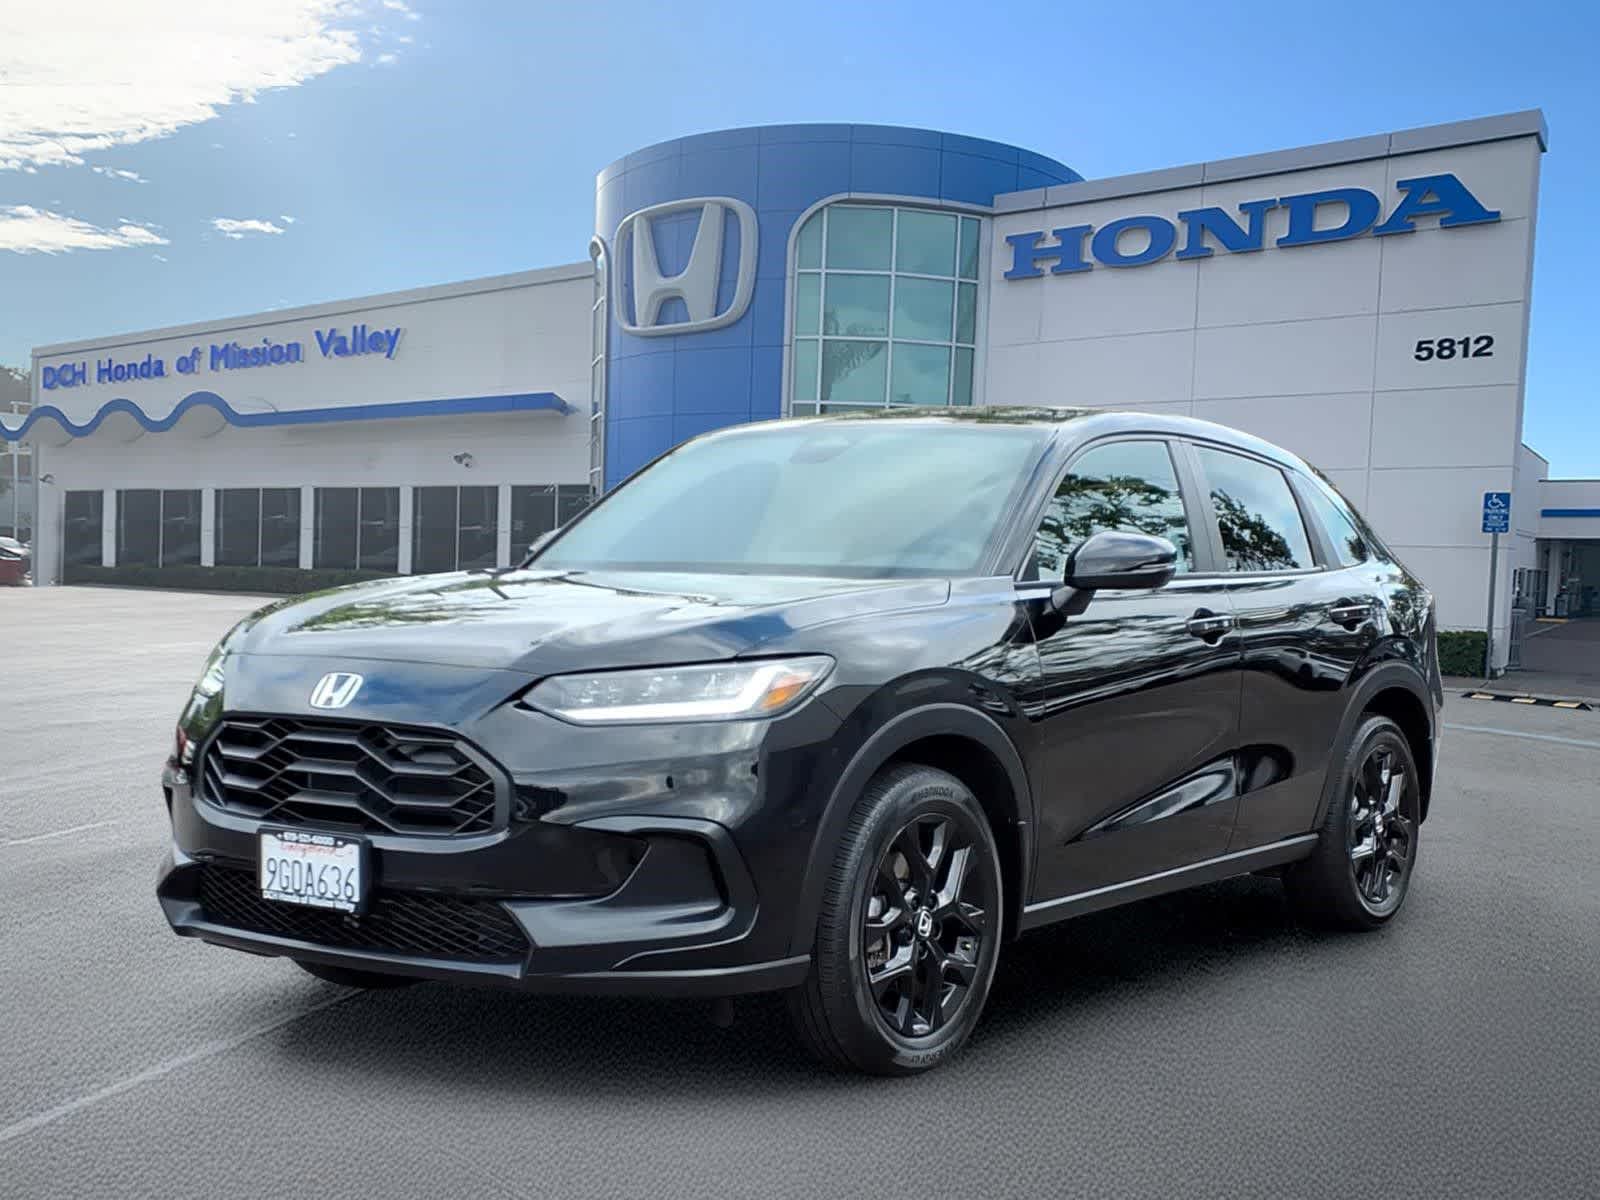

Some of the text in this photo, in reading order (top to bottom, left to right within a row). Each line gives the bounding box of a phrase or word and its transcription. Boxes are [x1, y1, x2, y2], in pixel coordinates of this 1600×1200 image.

[1004, 173, 1501, 280] HONDA
[42, 324, 402, 390] DCH Honda of Mission Valley
[1414, 335, 1495, 362] 5812
